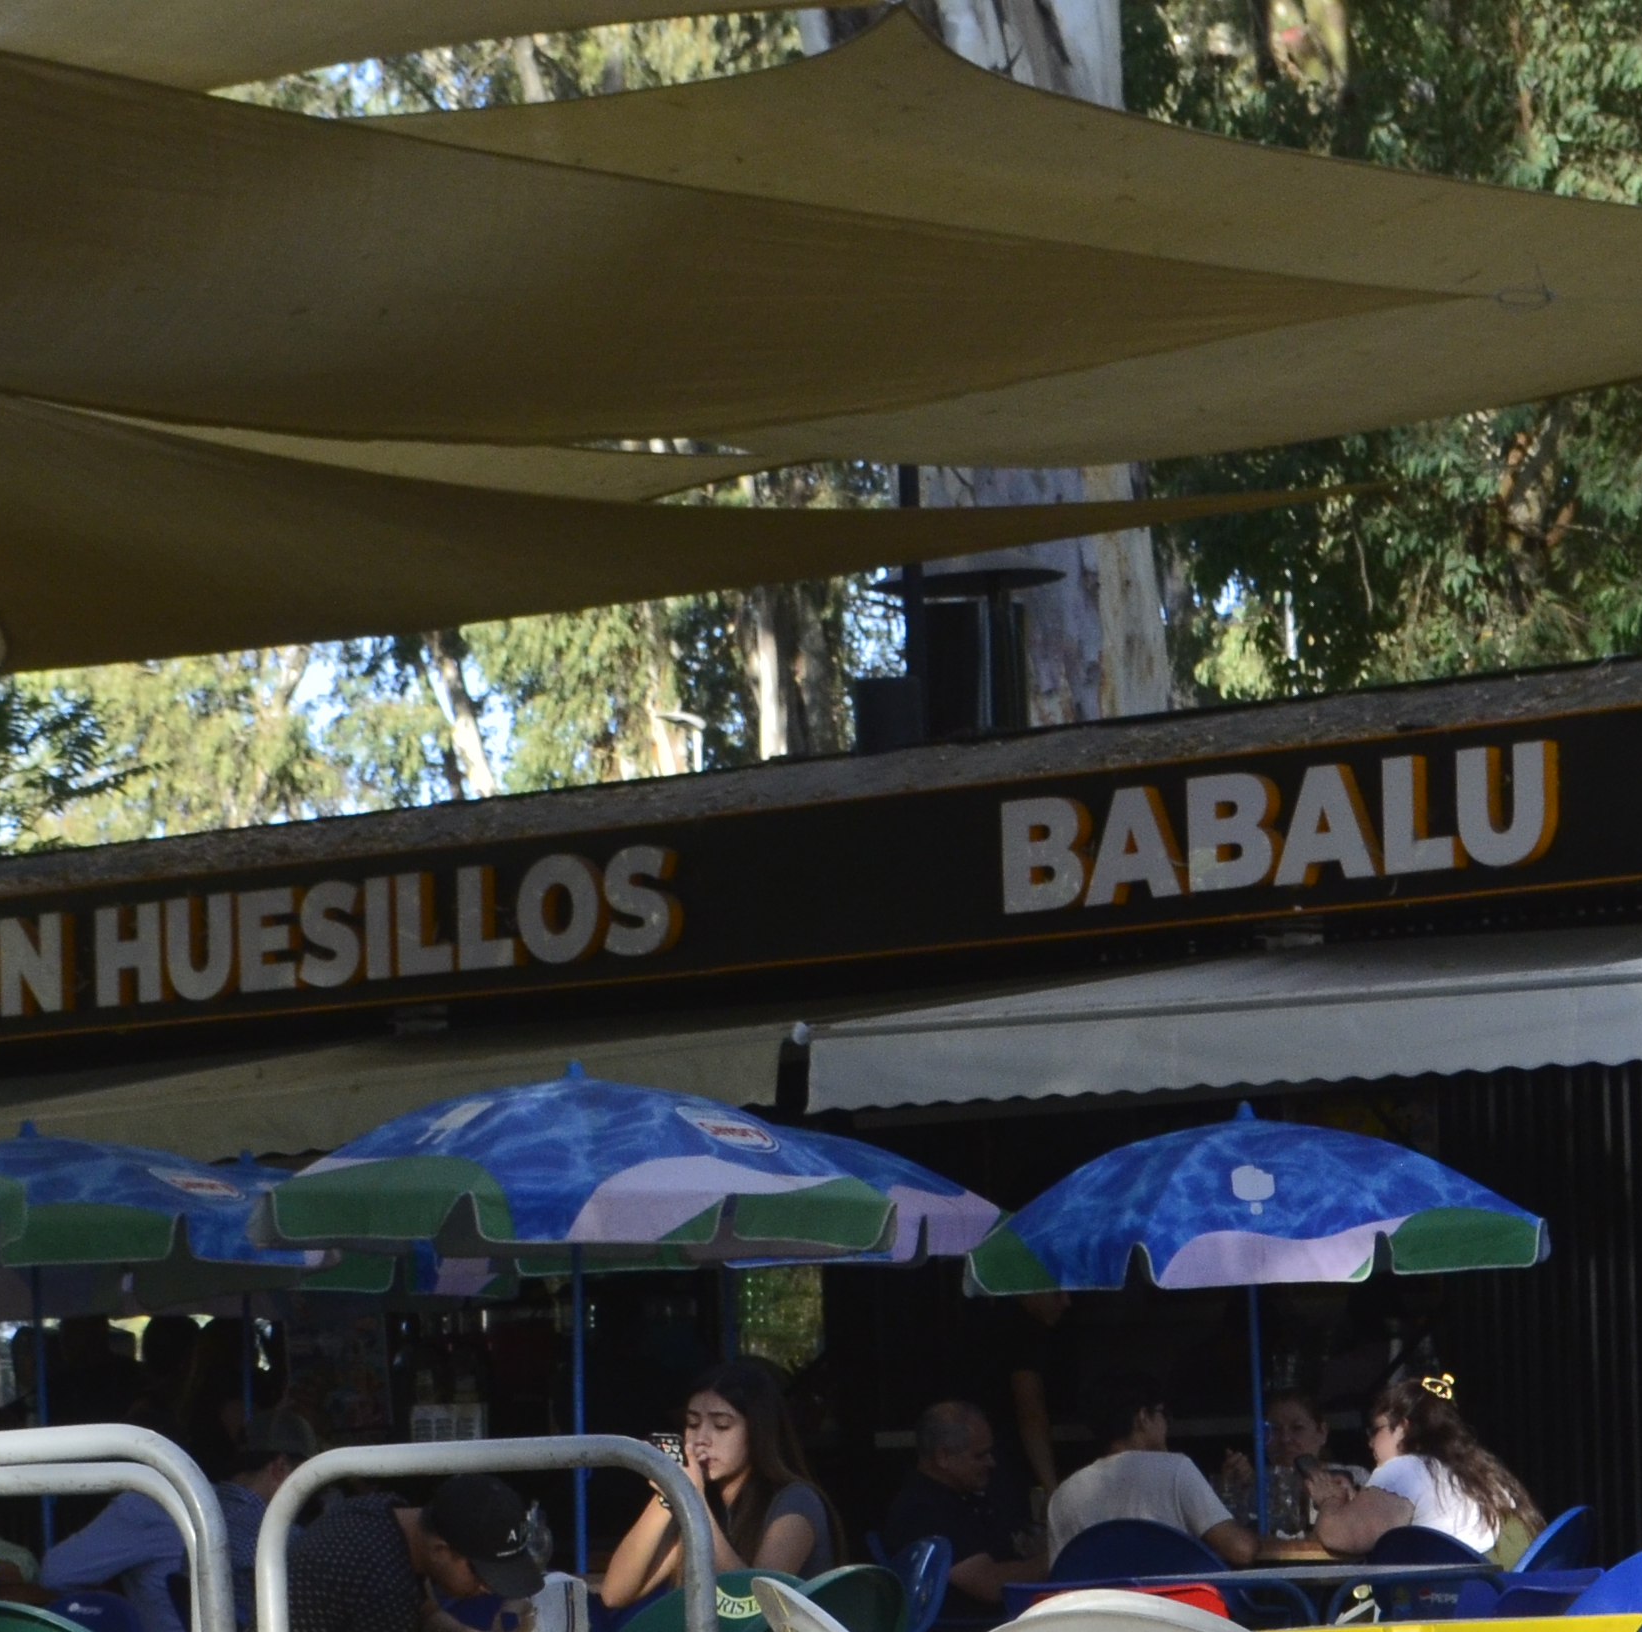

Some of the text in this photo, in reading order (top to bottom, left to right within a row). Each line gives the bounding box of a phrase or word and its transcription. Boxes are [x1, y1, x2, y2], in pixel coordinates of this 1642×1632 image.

[999, 740, 1554, 915] BABALU
[94, 842, 677, 1010] HUESILLOS
[716, 1597, 761, 1615] RIST
